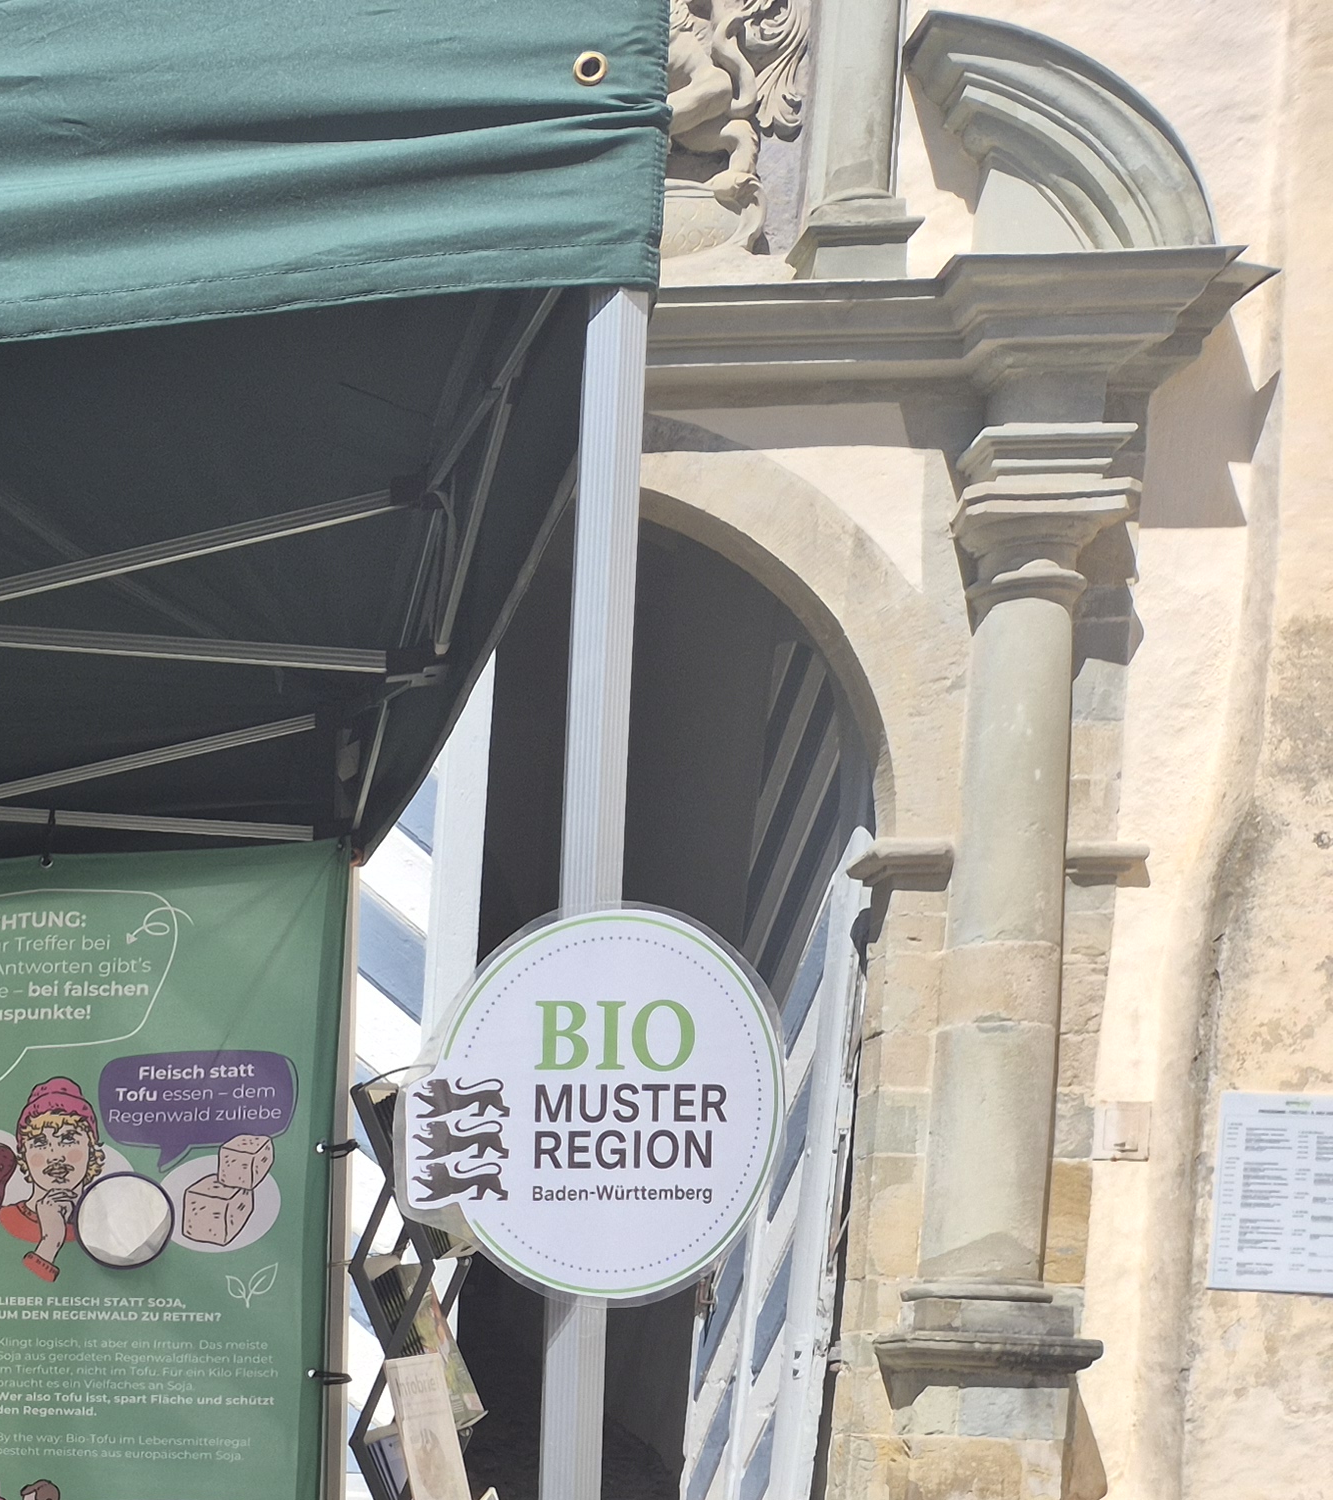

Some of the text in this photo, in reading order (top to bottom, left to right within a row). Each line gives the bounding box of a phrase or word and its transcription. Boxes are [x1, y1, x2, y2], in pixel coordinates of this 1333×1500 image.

[14, 935, 76, 952] Treffer
[81, 933, 111, 951] bei
[27, 981, 59, 997] bei
[62, 980, 149, 997] falschen
[533, 999, 696, 1071] BIO
[138, 1063, 255, 1080] Fleisch statt
[114, 1083, 275, 1102] Tofu essen dem
[534, 1083, 727, 1123] MUSTER
[108, 1104, 282, 1126] Regenwald zuliebe
[533, 1129, 712, 1169] REGION
[531, 1184, 712, 1203] Baden-Württemberg
[46, 1296, 100, 1306] FLEISCH
[103, 1296, 145, 1307] STATT
[147, 1297, 186, 1309] SOJA,
[21, 1309, 49, 1320] DEN
[52, 1310, 138, 1321] REGENWALD
[140, 1310, 159, 1322] ZU
[162, 1311, 222, 1322] RETTEN?
[24, 1391, 51, 1402] also
[53, 1391, 82, 1403] Tofu
[85, 1391, 111, 1404] isst,
[113, 1394, 147, 1405] spart
[150, 1393, 193, 1405] Fläche
[196, 1394, 222, 1405] und
[224, 1394, 274, 1406] schützt
[22, 1405, 97, 1417] Regenwald.
